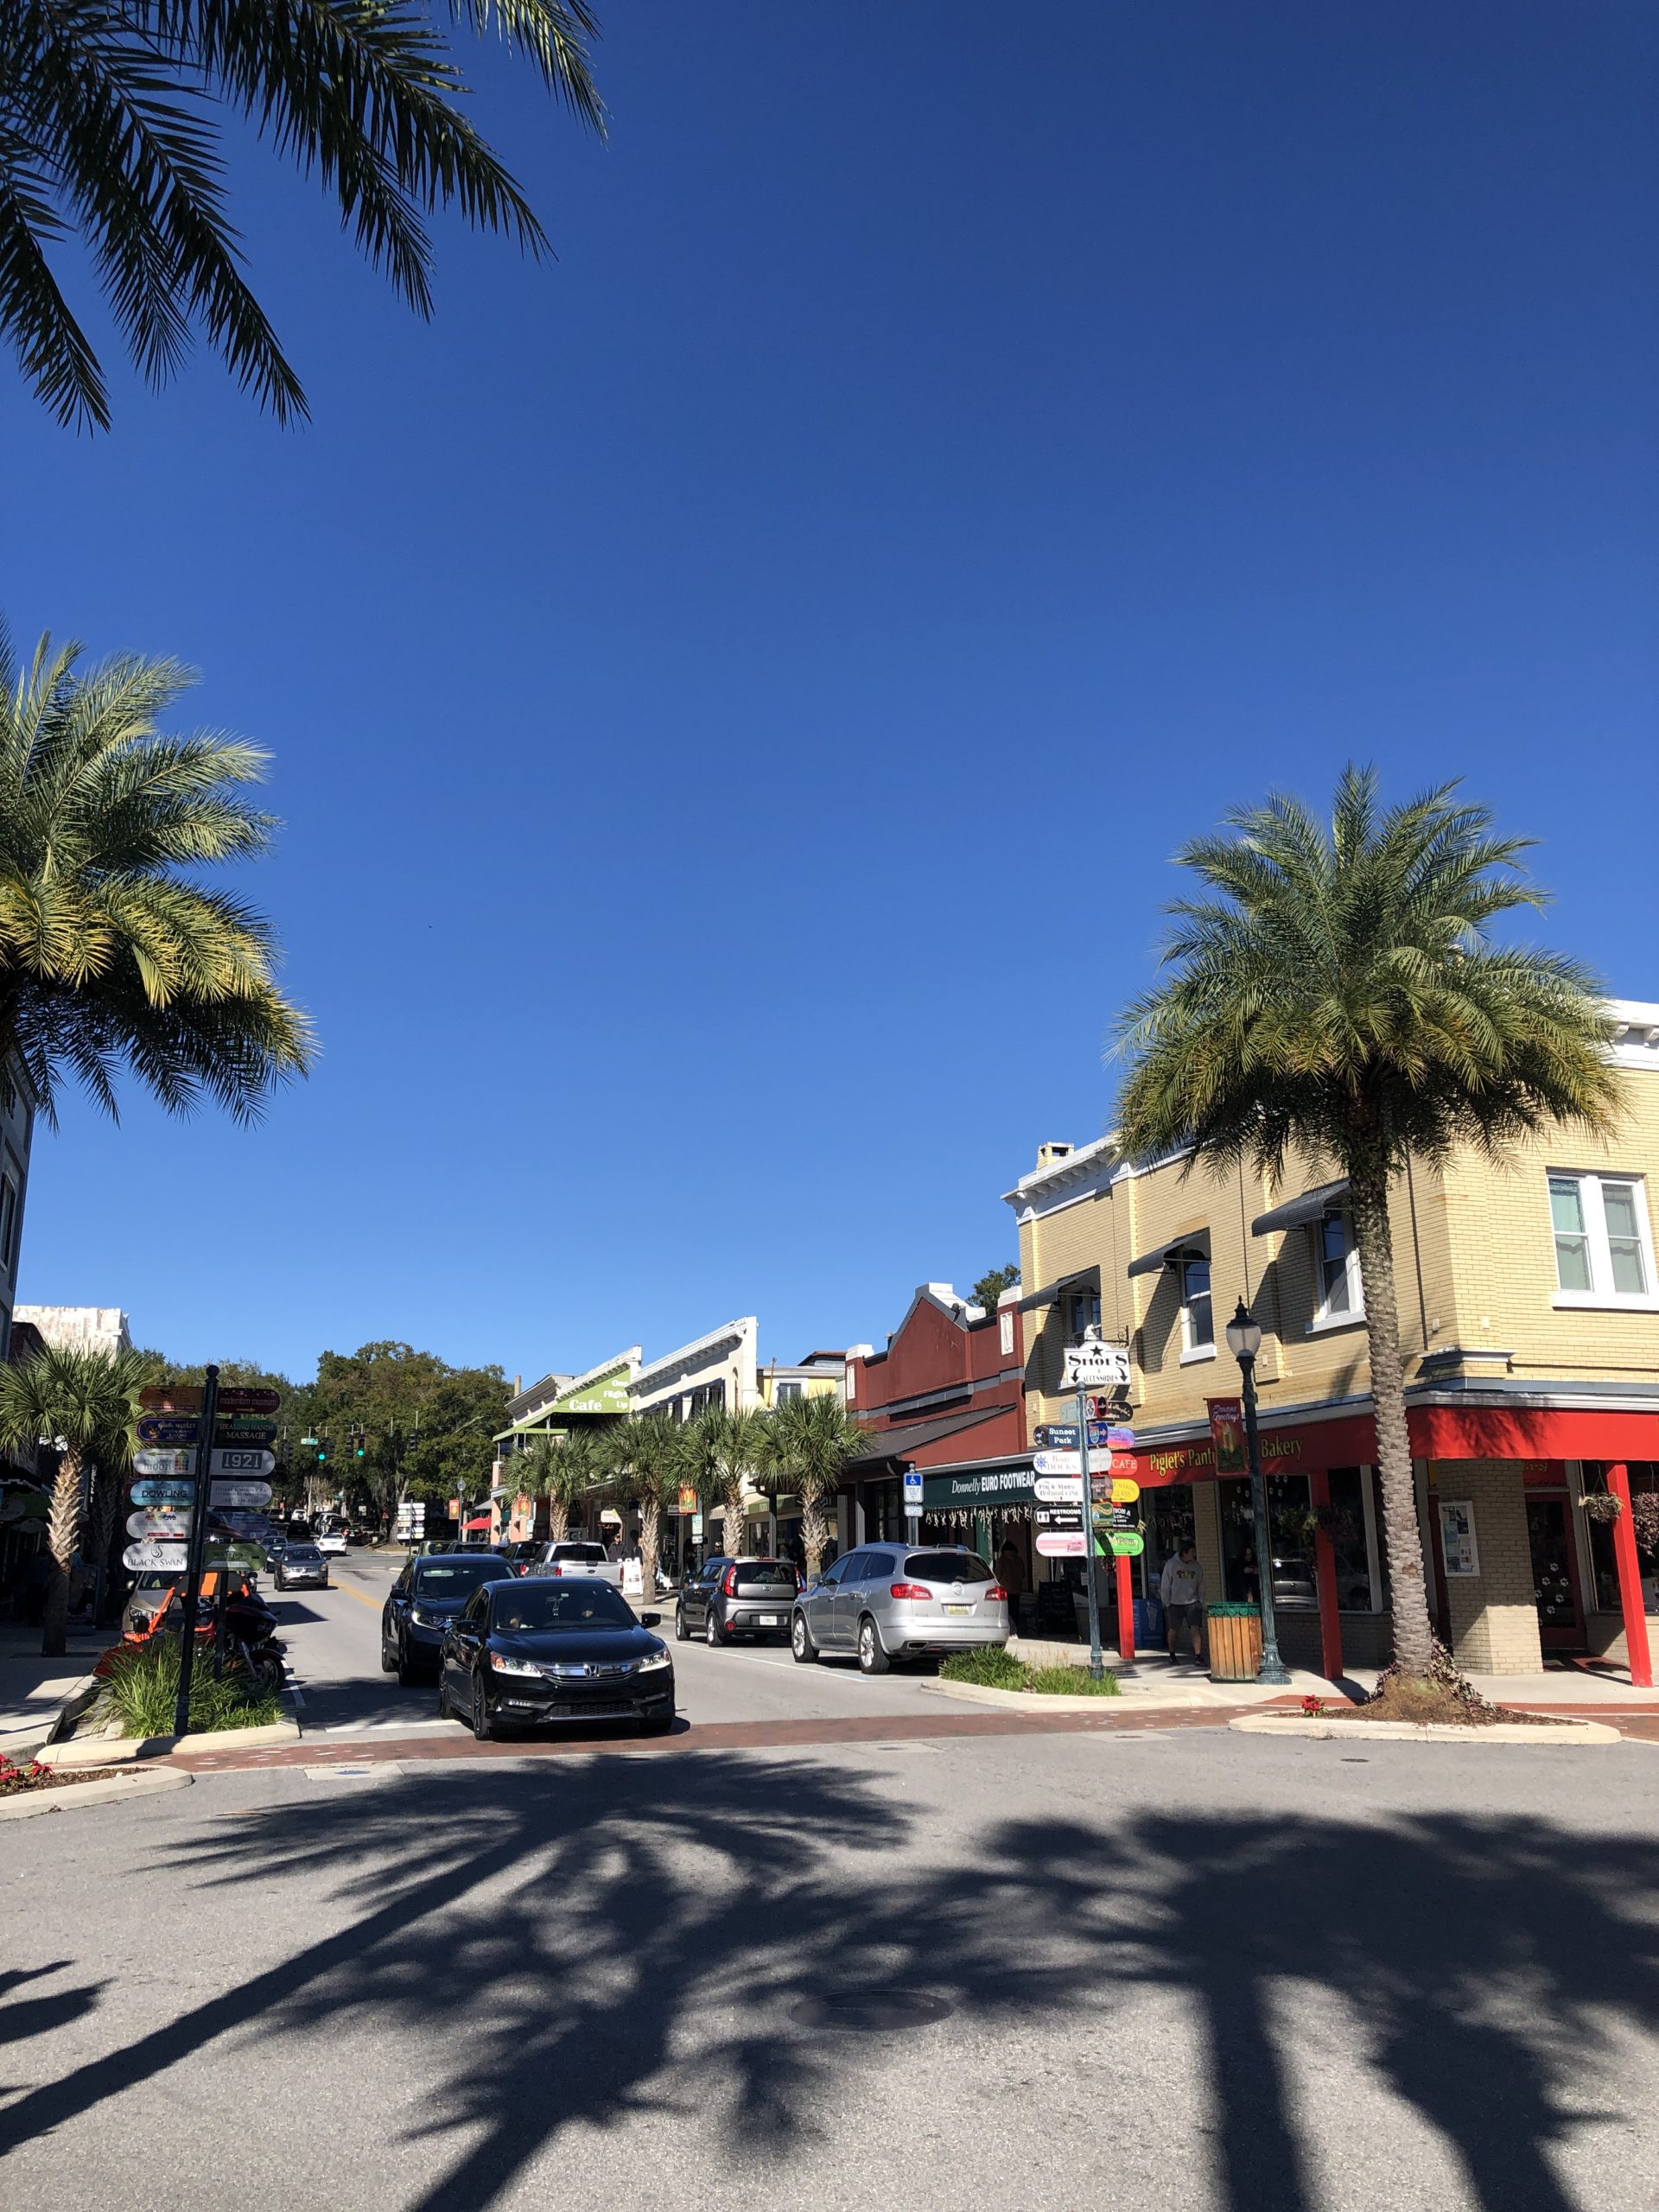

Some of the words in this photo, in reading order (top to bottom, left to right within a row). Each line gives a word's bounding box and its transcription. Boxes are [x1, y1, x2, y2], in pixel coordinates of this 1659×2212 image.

[1068, 1355, 1128, 1366] SHOES
[616, 1401, 628, 1409] Up
[225, 1453, 259, 1468] 1921
[1150, 1451, 1185, 1477] Piglet's
[1261, 1435, 1303, 1462] Bakery
[1112, 1459, 1137, 1469] CAFE
[951, 1477, 981, 1496] Donnelly
[981, 1475, 998, 1492] EURO
[999, 1471, 1036, 1491] FOOTWEAR
[142, 1490, 188, 1498] DOWLING
[127, 1558, 157, 1567] BLACK
[160, 1558, 183, 1567] SWAN
